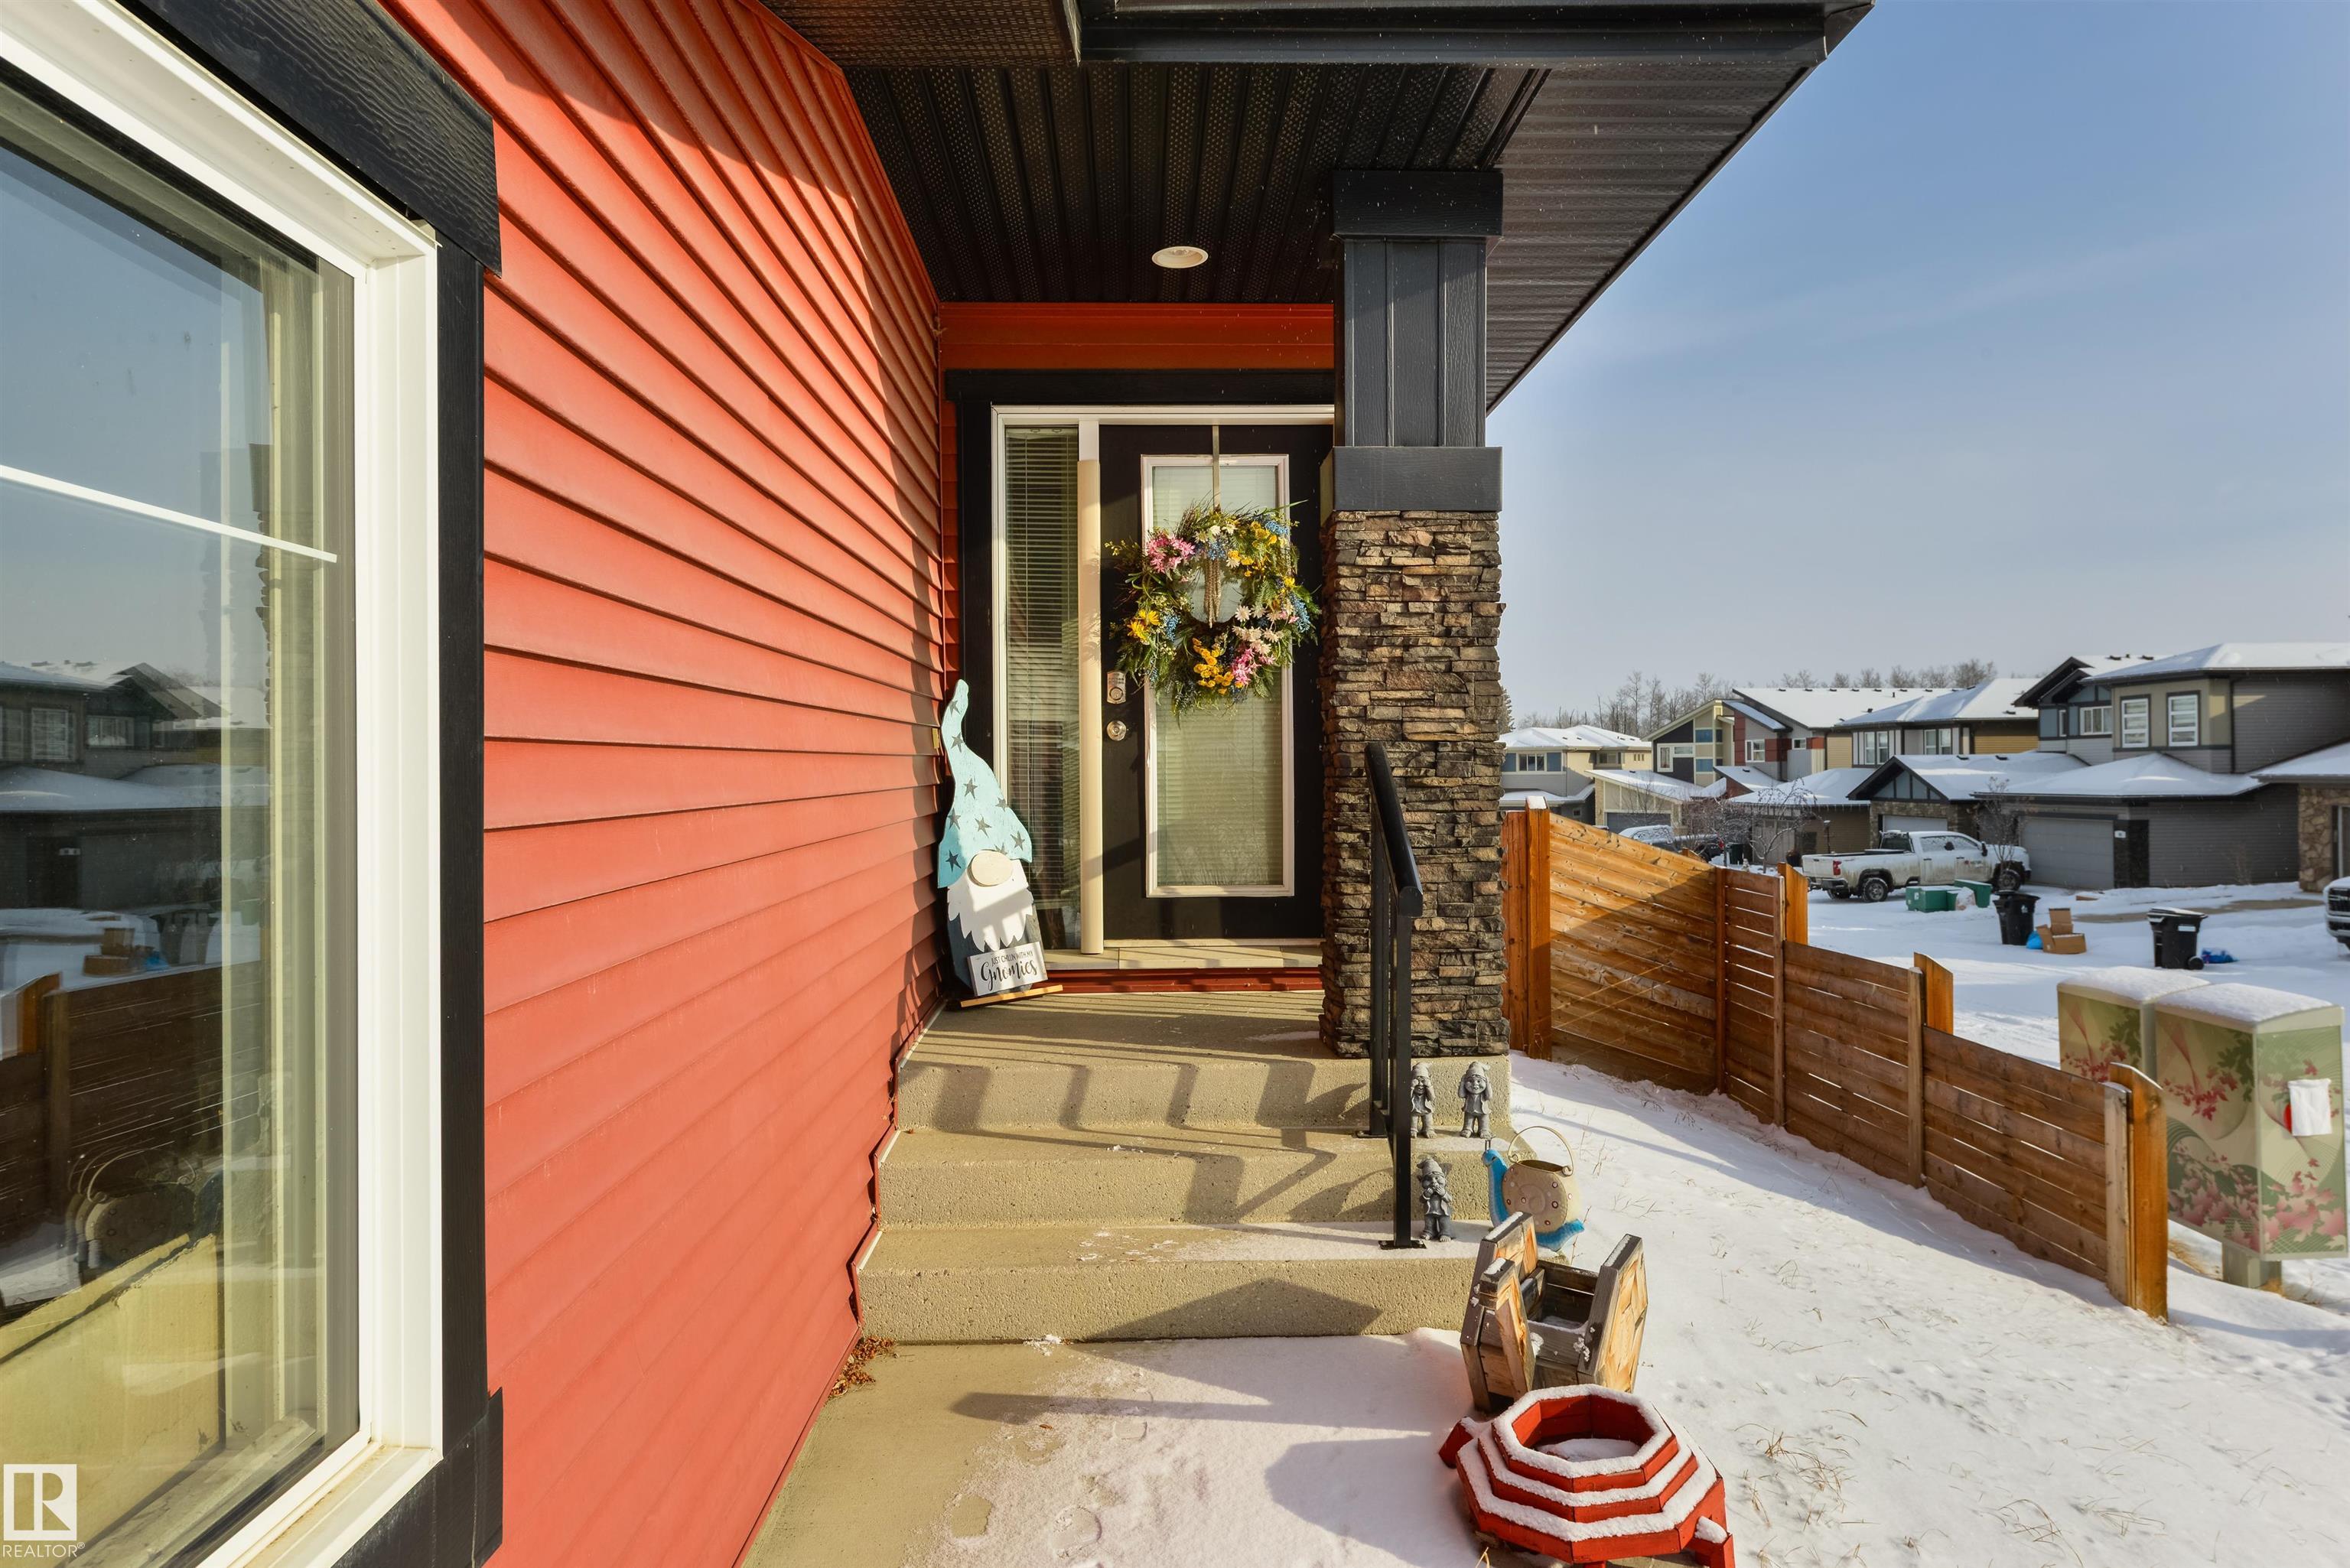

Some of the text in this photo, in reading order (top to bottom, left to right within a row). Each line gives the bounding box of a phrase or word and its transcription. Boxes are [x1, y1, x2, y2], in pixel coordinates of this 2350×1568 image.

[991, 956, 1001, 967] JUST
[1016, 952, 1026, 960] WITH
[981, 960, 1037, 991] Gnomies
